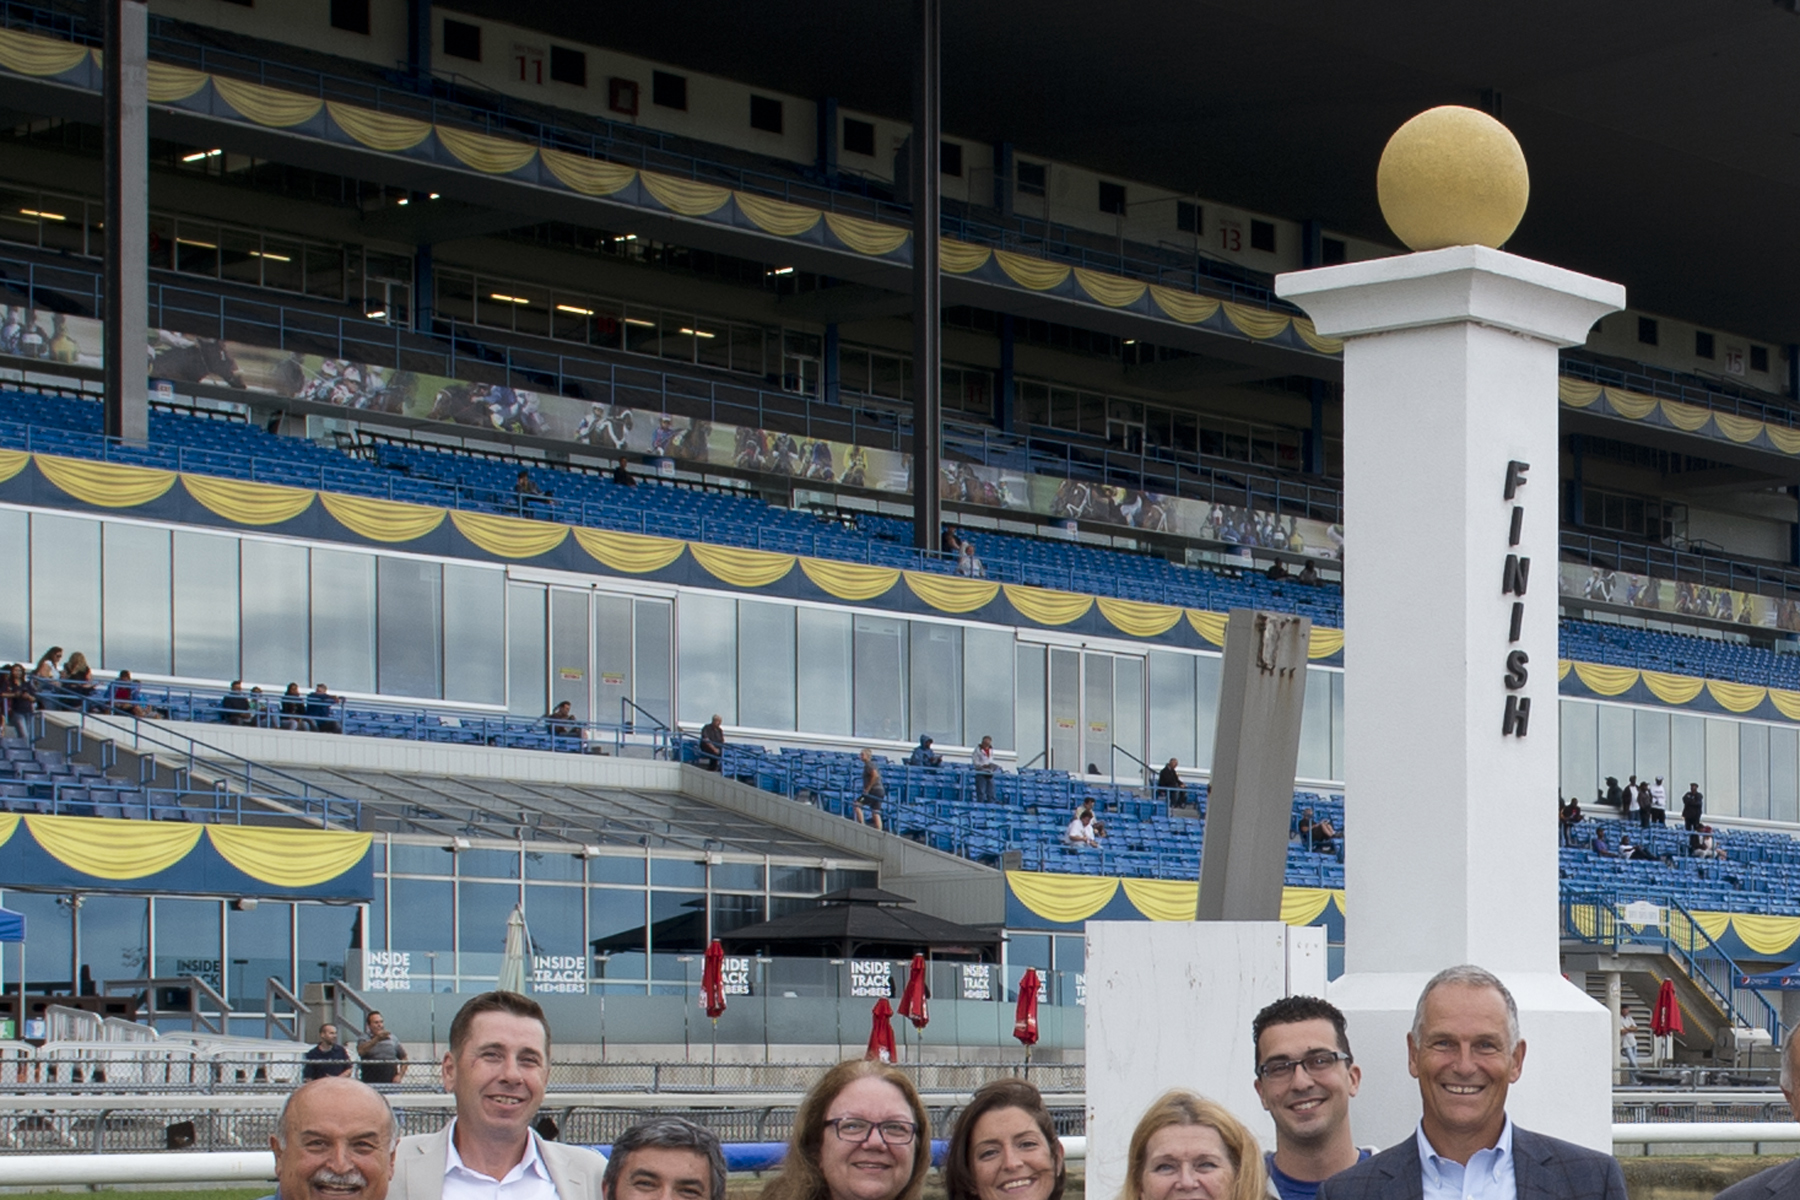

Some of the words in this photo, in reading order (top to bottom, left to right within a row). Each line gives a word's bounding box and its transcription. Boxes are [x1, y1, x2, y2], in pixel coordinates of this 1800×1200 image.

[515, 55, 543, 85] 11
[1219, 228, 1242, 252] 13
[1726, 352, 1743, 374] 15
[1502, 460, 1531, 738] FINISH
[368, 952, 411, 966] INSIDE
[534, 956, 585, 970] INSIDE
[701, 958, 750, 972] IIDE
[368, 966, 411, 979] TRACK
[850, 961, 891, 974] INSIDE
[963, 964, 990, 978] INSIDE
[534, 971, 585, 982] TRACK
[851, 975, 891, 987] TRACK
[963, 977, 990, 989] TRACK
[534, 983, 585, 994] MEMBERS
